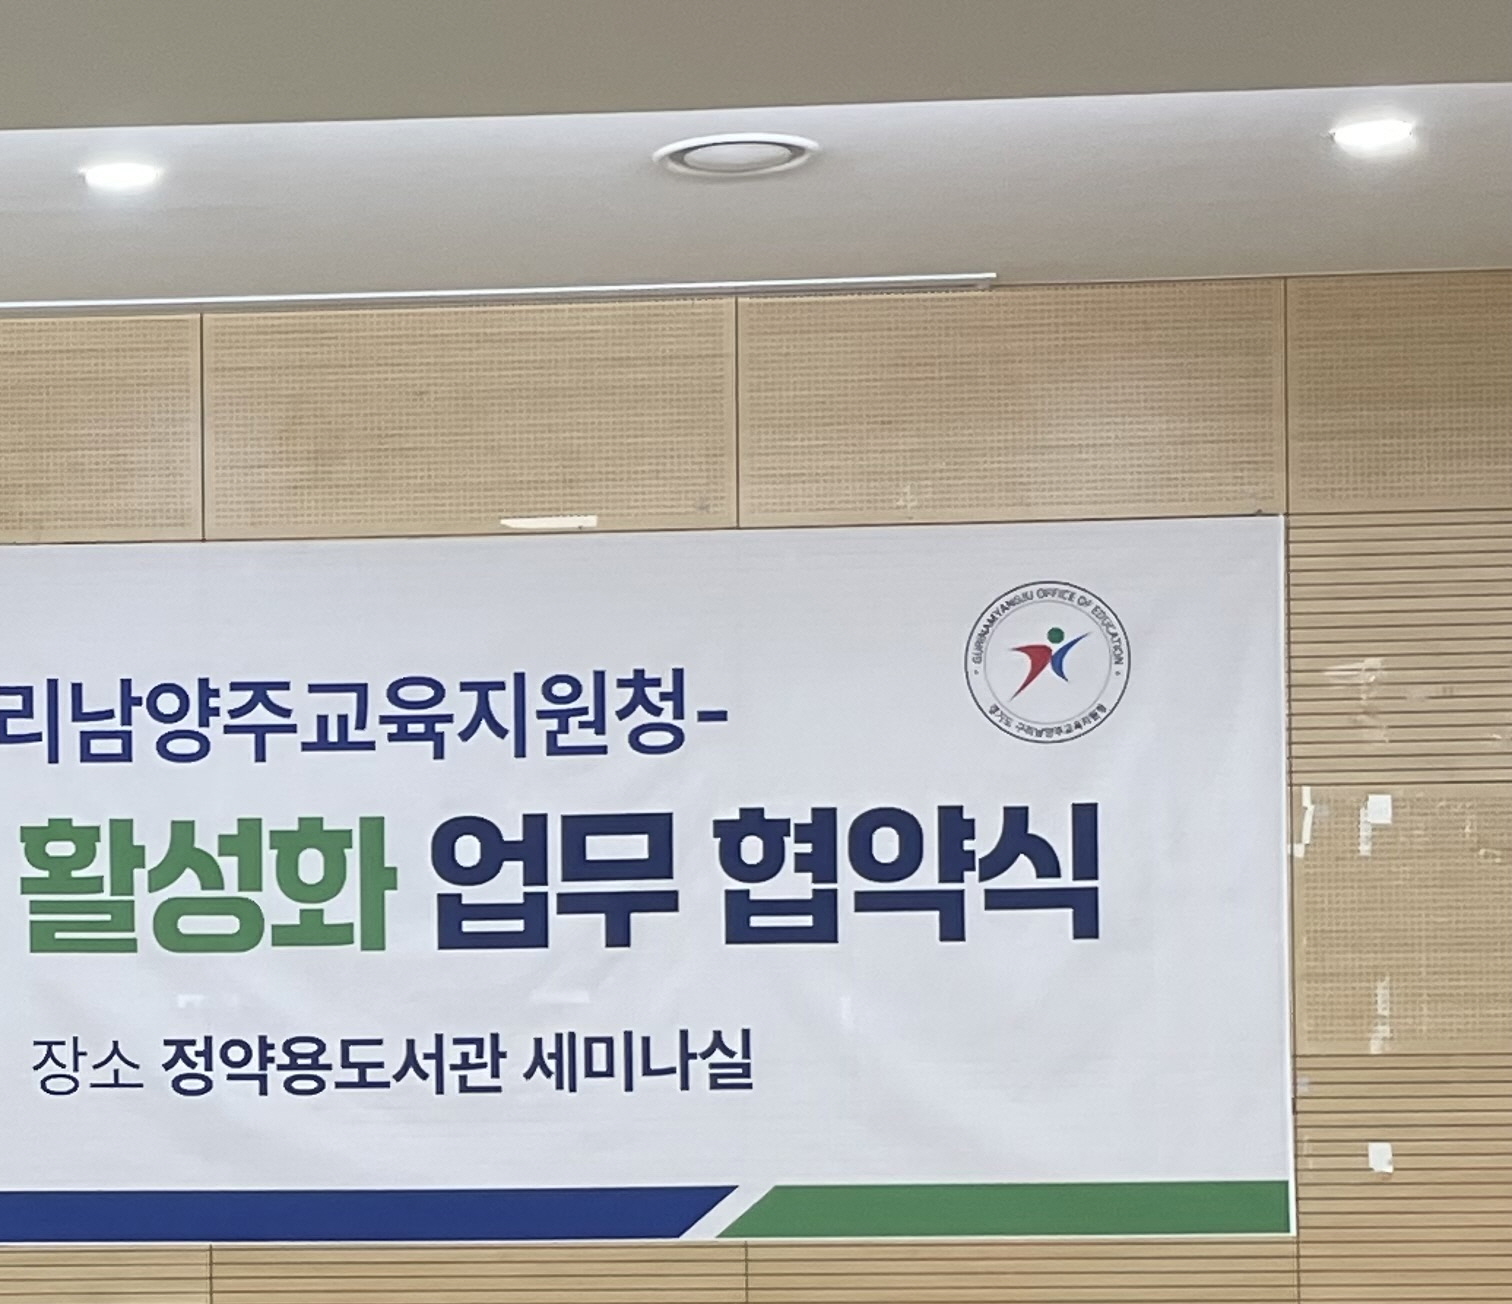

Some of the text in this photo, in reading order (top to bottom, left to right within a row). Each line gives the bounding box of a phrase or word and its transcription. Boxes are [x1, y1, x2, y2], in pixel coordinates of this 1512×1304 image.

[1036, 587, 1076, 602] OFFICE
[19, 815, 398, 954] 활성화
[430, 811, 680, 951] 업무
[713, 802, 1100, 946] 협약식
[32, 1028, 754, 1097] 장소 정약용도서관 세미나실
